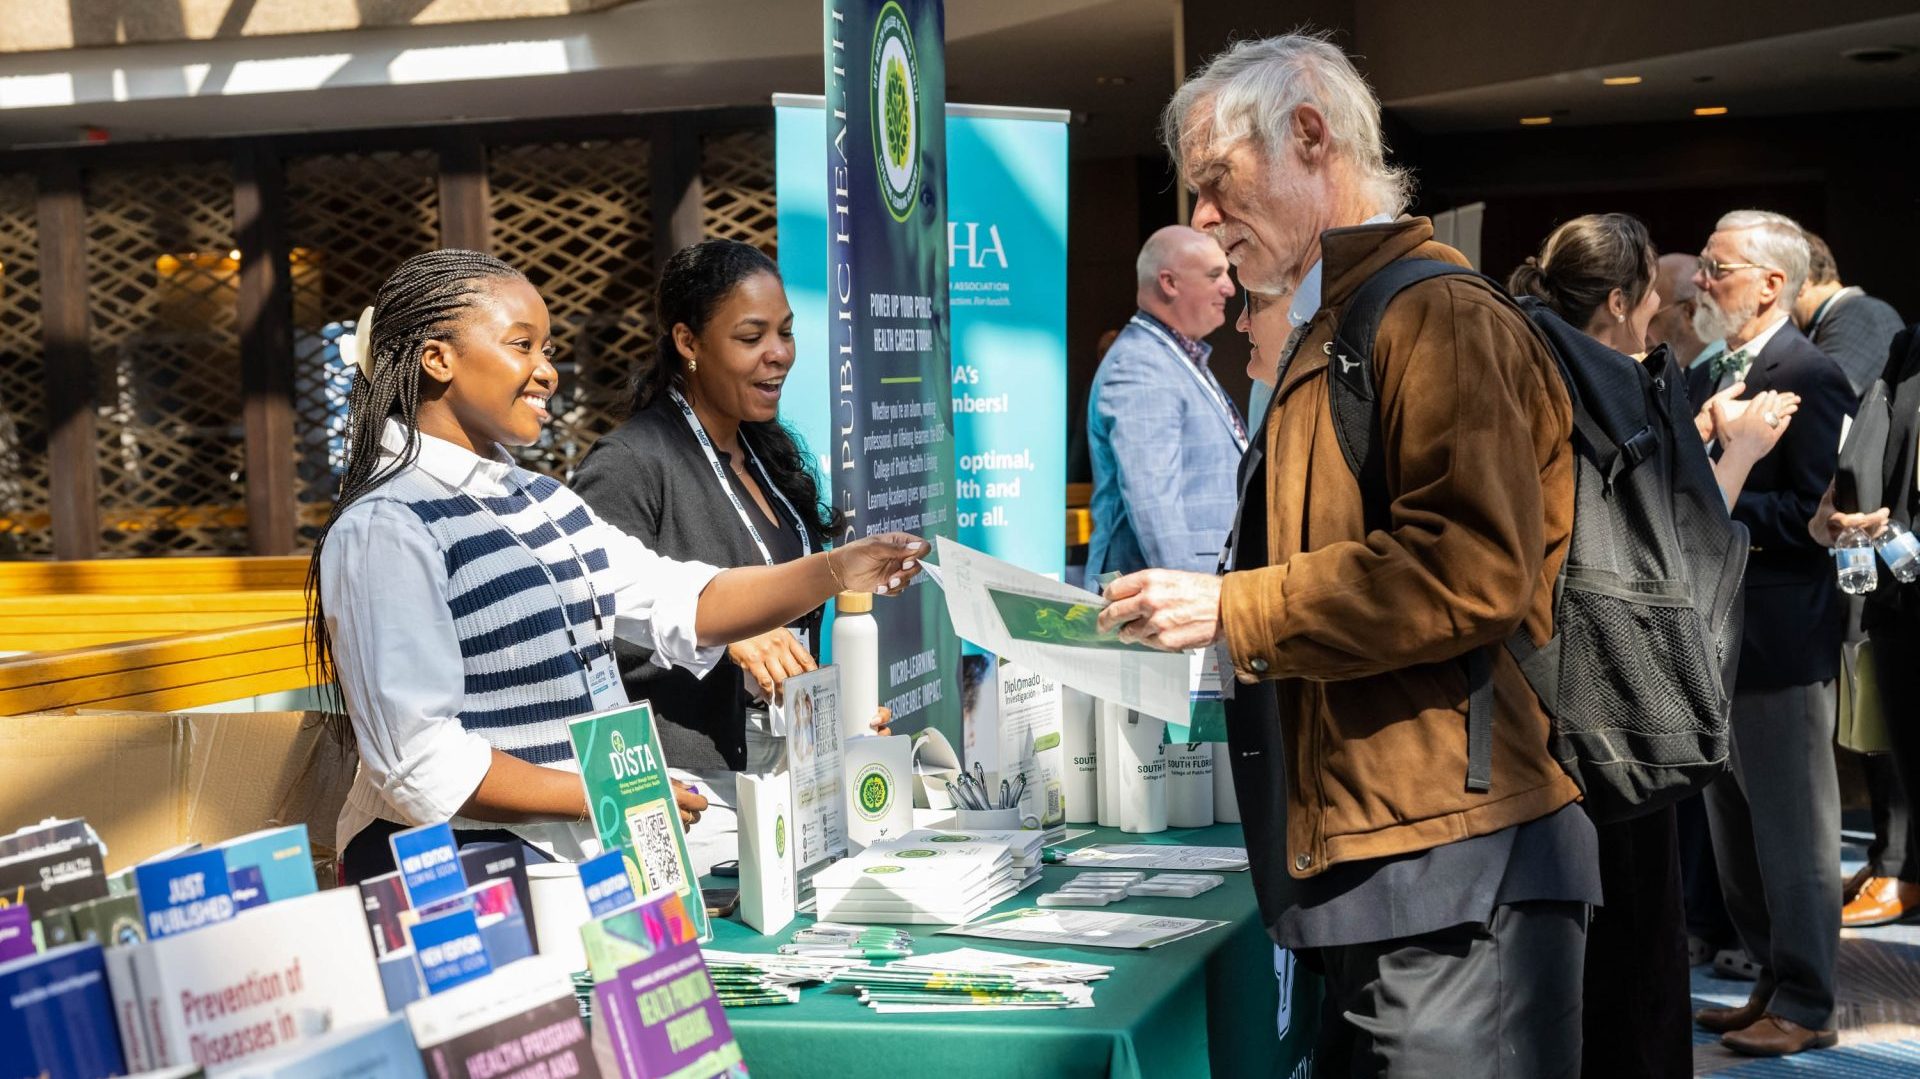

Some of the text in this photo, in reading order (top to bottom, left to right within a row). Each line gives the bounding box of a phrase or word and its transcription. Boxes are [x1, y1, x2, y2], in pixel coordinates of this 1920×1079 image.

[832, 9, 850, 243] HEALTH
[954, 282, 1010, 291] ASSOCIATION
[870, 294, 932, 319] POWER UP YOUR PUBLIC
[874, 328, 894, 352] HEALTH
[894, 328, 915, 352] CAREER
[838, 263, 855, 471] PUBLIC
[951, 366, 979, 385] A's
[872, 401, 890, 421] Whether
[874, 460, 890, 481] College
[895, 456, 909, 475] Public
[909, 454, 923, 473] Health
[959, 448, 1034, 474] optimal,
[868, 490, 888, 511] Learning
[889, 486, 908, 507] Academy
[986, 477, 1021, 499] and
[982, 506, 1009, 527] all.
[1138, 765, 1162, 774] SOUTH
[1168, 760, 1191, 769] SOUTH
[168, 872, 206, 904] JUST
[148, 894, 236, 936] PUBLISHED
[180, 956, 305, 1026] Prevention of
[189, 1021, 276, 1068] Diseases
[276, 1010, 296, 1042] in
[466, 1038, 522, 1079] HEALTH
[520, 1015, 586, 1062] PROGRAM
